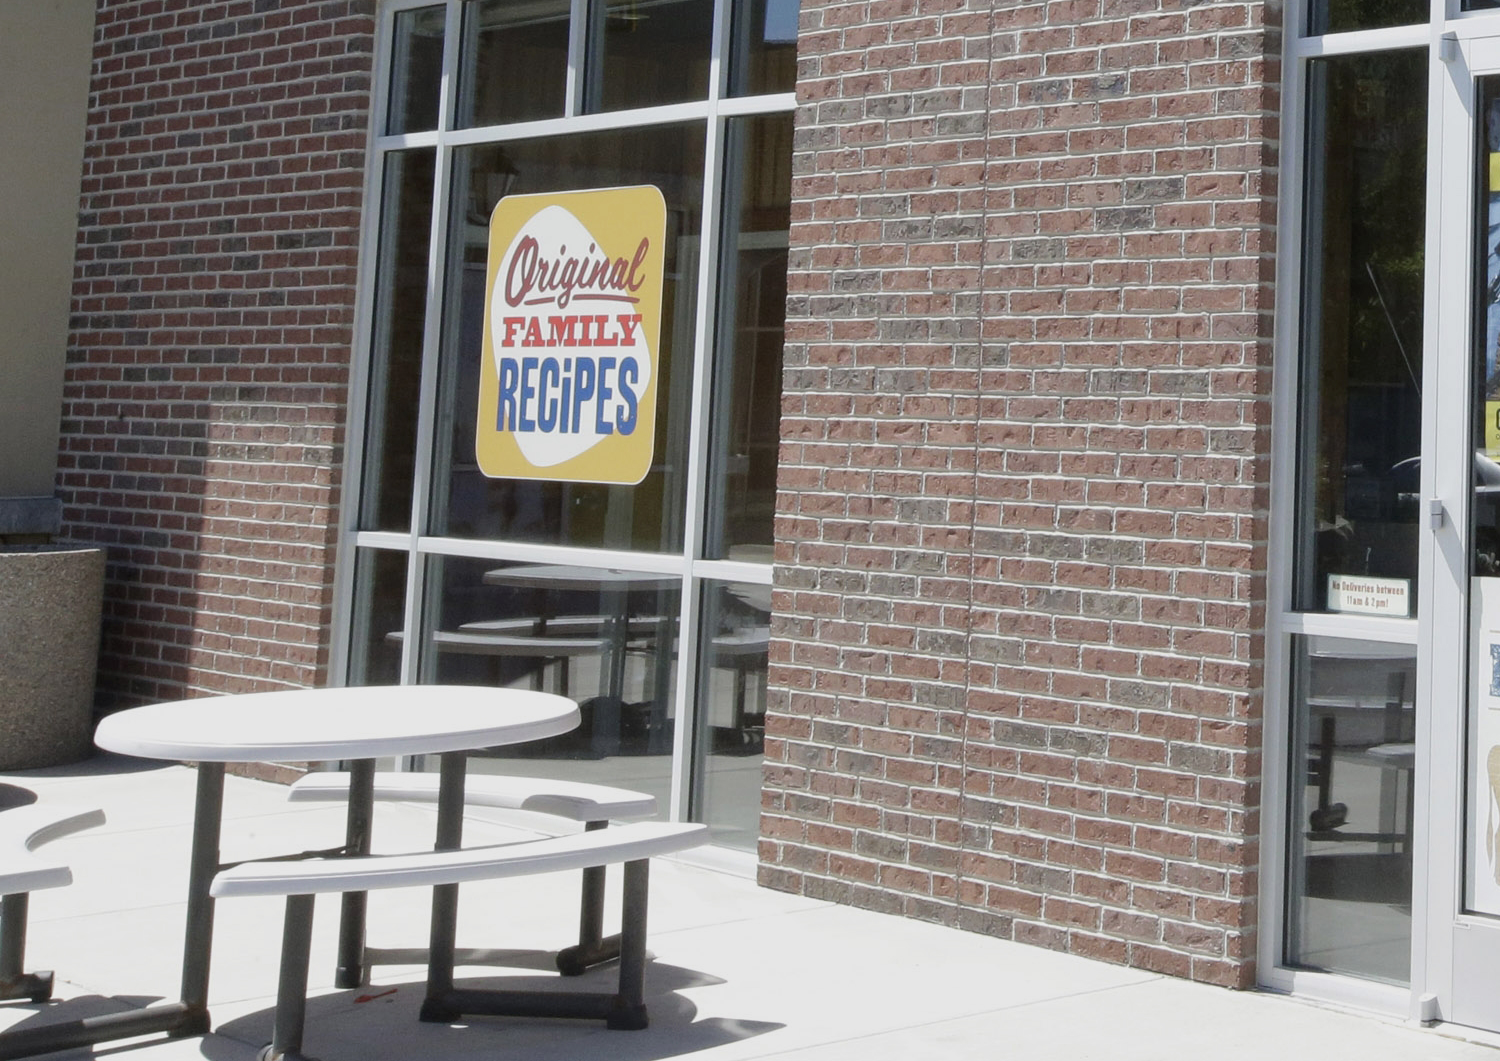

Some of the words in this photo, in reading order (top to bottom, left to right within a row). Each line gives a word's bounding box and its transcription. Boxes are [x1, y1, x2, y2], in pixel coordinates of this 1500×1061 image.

[505, 234, 650, 310] Original
[501, 313, 643, 348] FAMILY
[1332, 580, 1341, 590] No
[1342, 581, 1375, 593] Deliveries
[1376, 584, 1404, 595] between
